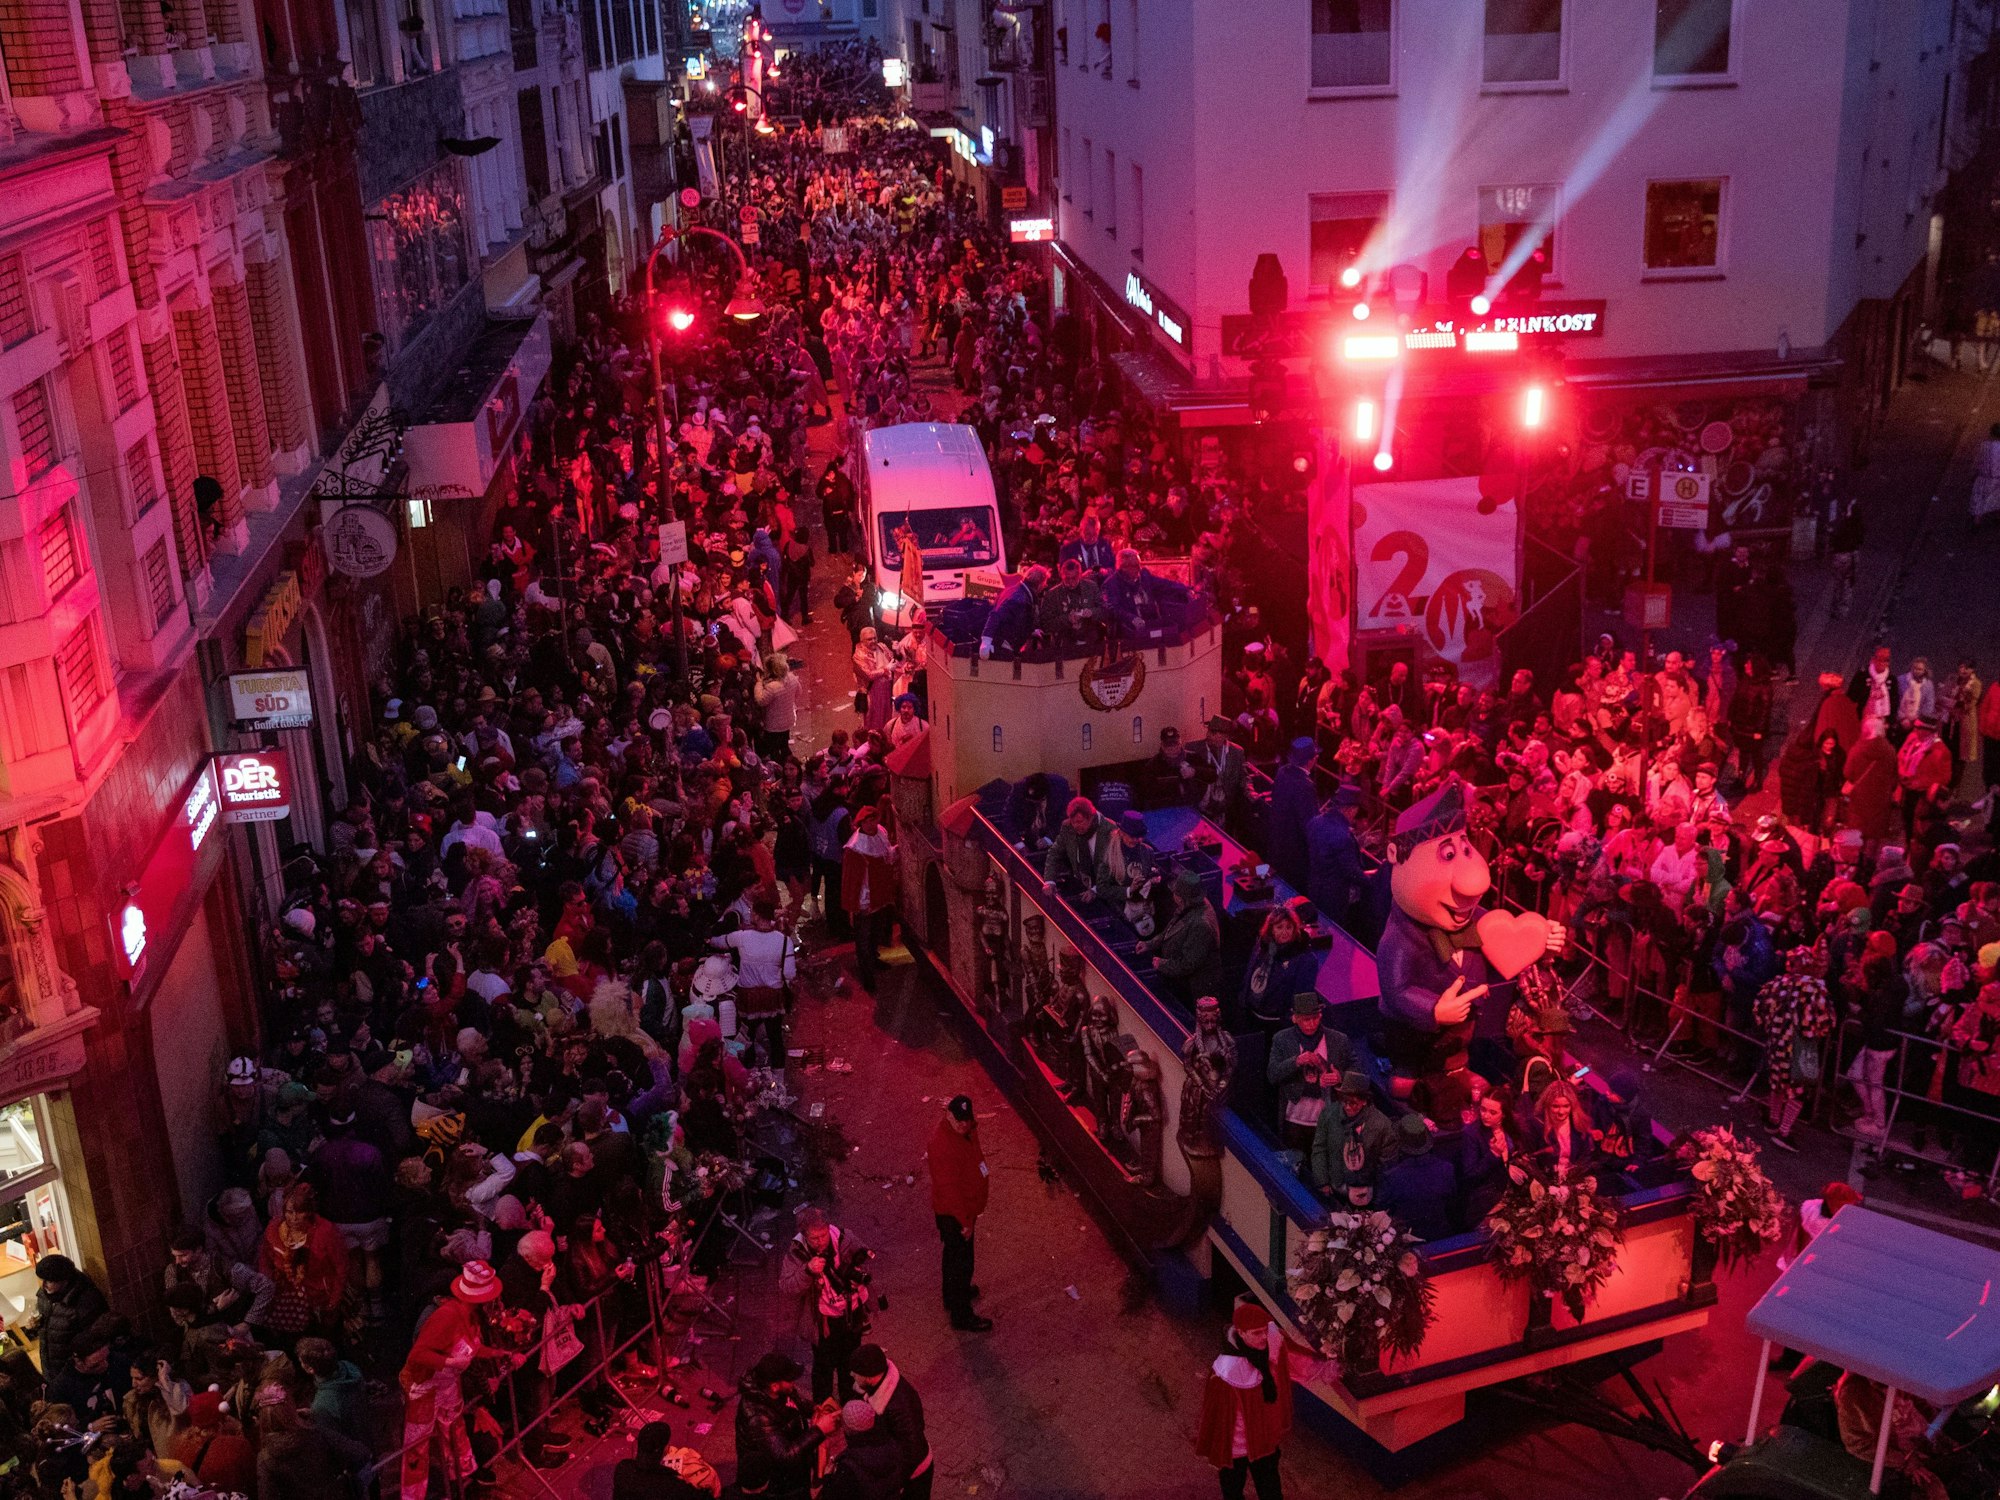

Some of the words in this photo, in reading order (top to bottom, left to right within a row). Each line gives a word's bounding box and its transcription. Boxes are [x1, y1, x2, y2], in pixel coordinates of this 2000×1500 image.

[1631, 479, 1646, 498] E
[934, 581, 957, 590] Ford
[977, 575, 1001, 585] Gruppe
[236, 675, 302, 695] TURISTA
[255, 694, 290, 713] SÜD
[223, 764, 280, 792] DER
[228, 789, 281, 803] Touristik
[235, 809, 278, 821] Partner
